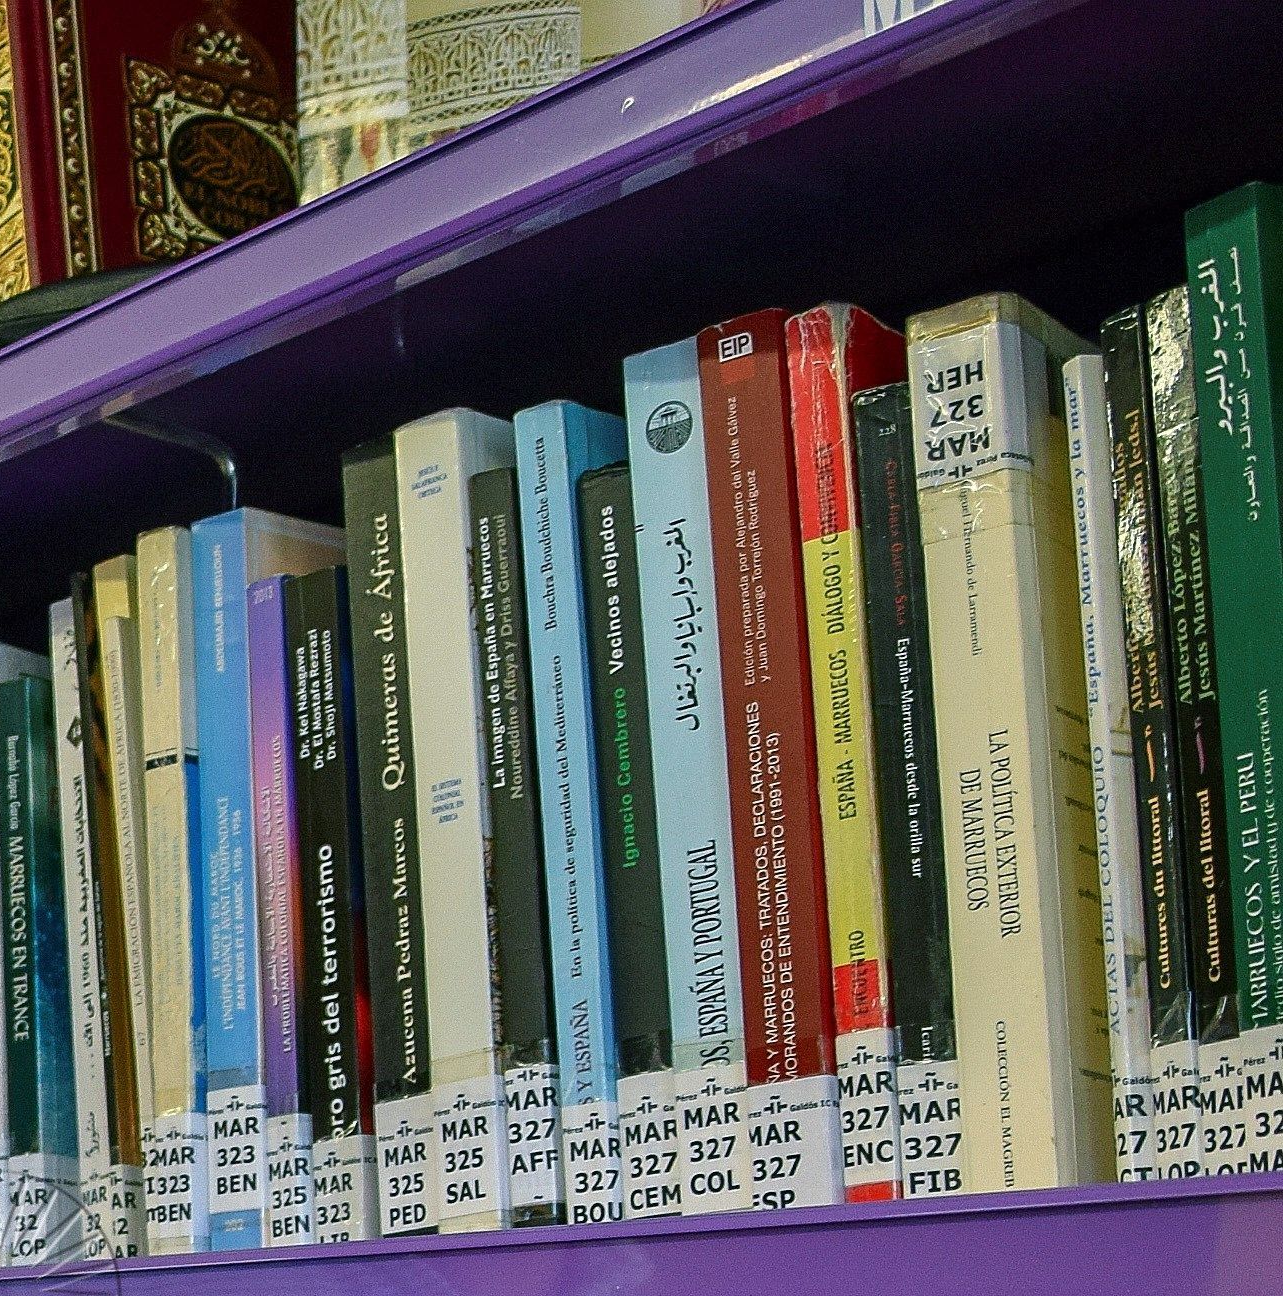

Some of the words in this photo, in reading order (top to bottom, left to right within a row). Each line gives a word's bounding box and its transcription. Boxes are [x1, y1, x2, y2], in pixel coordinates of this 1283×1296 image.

[720, 336, 753, 358] EIP
[366, 513, 395, 599] África
[599, 506, 620, 588] alejados
[663, 518, 691, 573] المغرب
[821, 549, 840, 560] Y
[374, 611, 394, 641] de
[819, 565, 845, 633] DIÁLOGO
[604, 595, 625, 674] Vecinos
[551, 655, 567, 752] Mediterráneo
[673, 641, 704, 731] والبرتغال
[830, 650, 853, 743] MARRUECOS
[381, 653, 405, 790] Quimeras
[613, 688, 632, 787] Cembrero
[988, 729, 1010, 750] LA
[554, 756, 570, 778] del
[827, 760, 856, 819] ESPAÑA
[959, 769, 981, 794] DE
[558, 782, 577, 853] seguridad
[991, 757, 1018, 841] POLÍTICA
[1195, 789, 1214, 852] litoral
[393, 818, 408, 899] Marcos
[618, 794, 639, 868] Ignacio
[960, 798, 989, 911] MARRUECOS
[563, 858, 576, 874] de
[686, 840, 723, 943] PORTUGAL
[996, 846, 1021, 938] EXTERIOR
[1199, 858, 1218, 888] del
[317, 845, 337, 985] terrorismo
[562, 880, 582, 933] política
[396, 905, 412, 980] Pedraz
[569, 939, 581, 952] la
[571, 956, 582, 978] En
[693, 947, 723, 961] Y
[1202, 895, 1223, 983] Culturas
[322, 994, 341, 1033] del
[688, 966, 728, 1037] ESPAÑA
[323, 1042, 346, 1090] gris
[400, 988, 416, 1083] Azucena
[625, 1120, 679, 1146] MAR
[684, 1103, 741, 1129] MAR
[630, 1152, 678, 1177] 327
[689, 1136, 737, 1162] 327
[629, 1184, 682, 1210] CEM
[689, 1171, 741, 1196] COL
